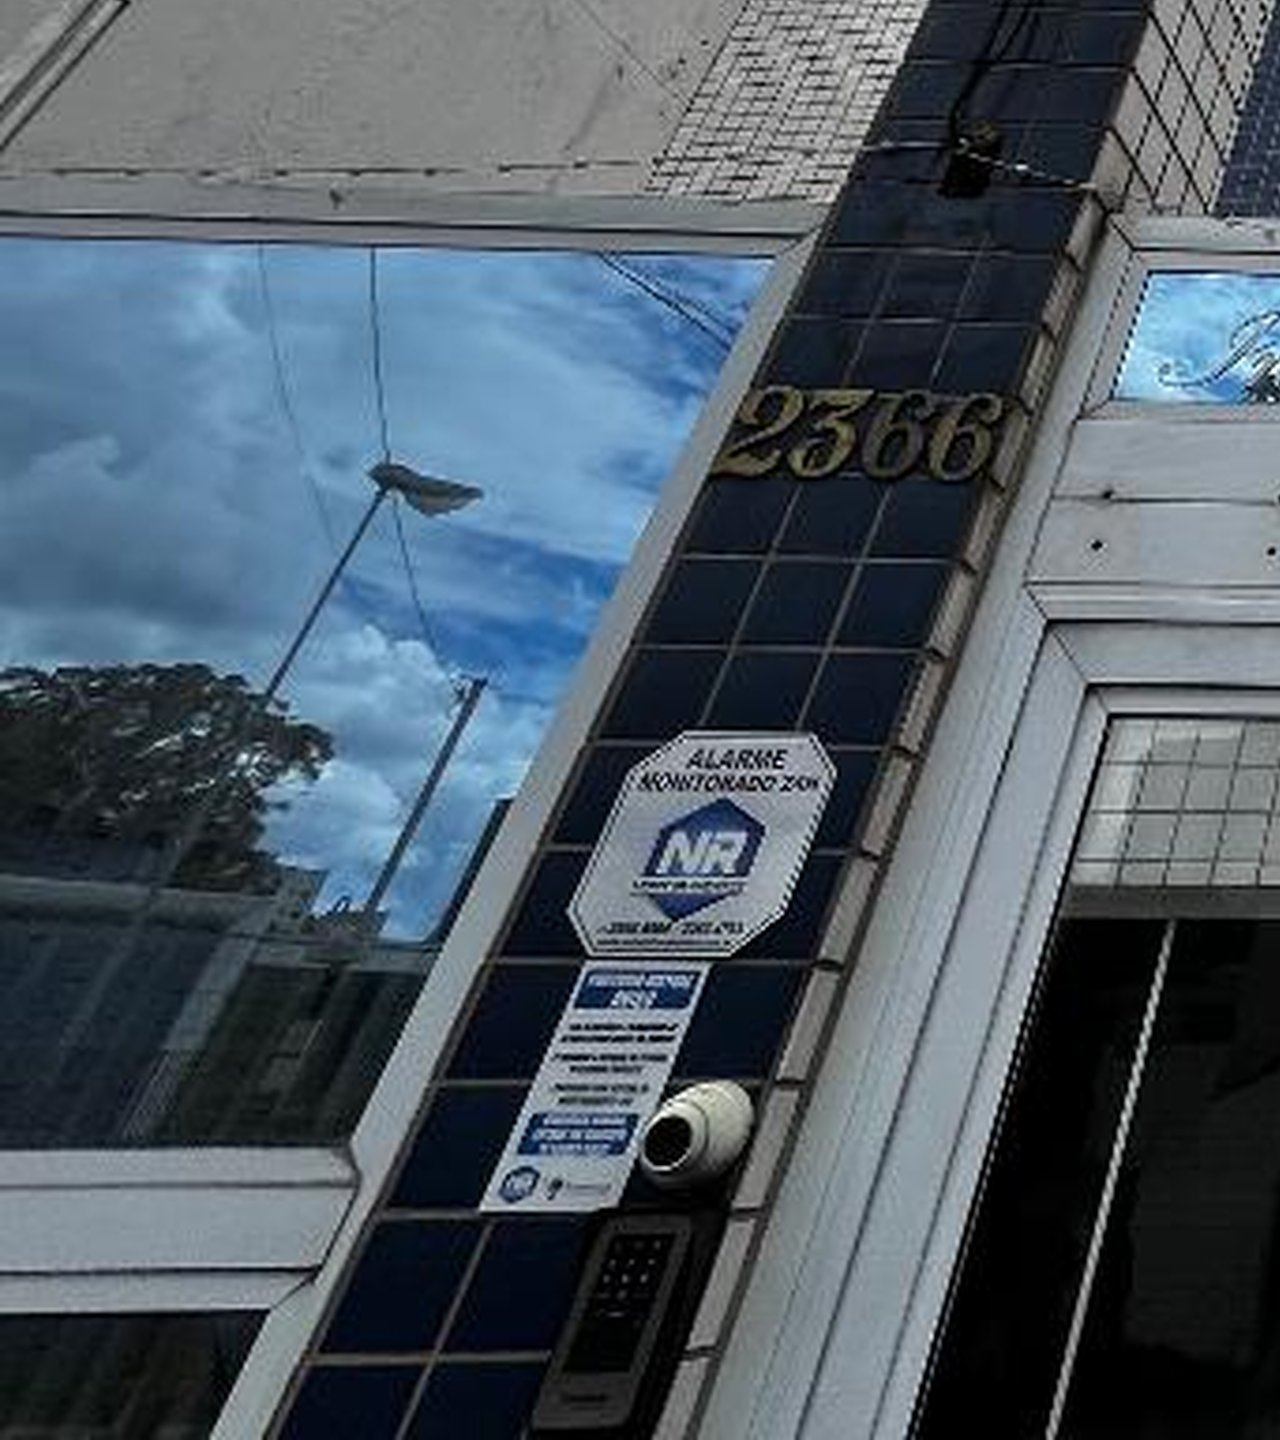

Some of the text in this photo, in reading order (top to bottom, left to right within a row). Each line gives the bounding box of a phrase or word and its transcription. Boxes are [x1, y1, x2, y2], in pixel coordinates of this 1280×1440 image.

[710, 384, 1003, 483] 2366
[686, 749, 788, 770] ALARME
[637, 772, 777, 793] MONITORADO
[655, 830, 748, 875] NR
